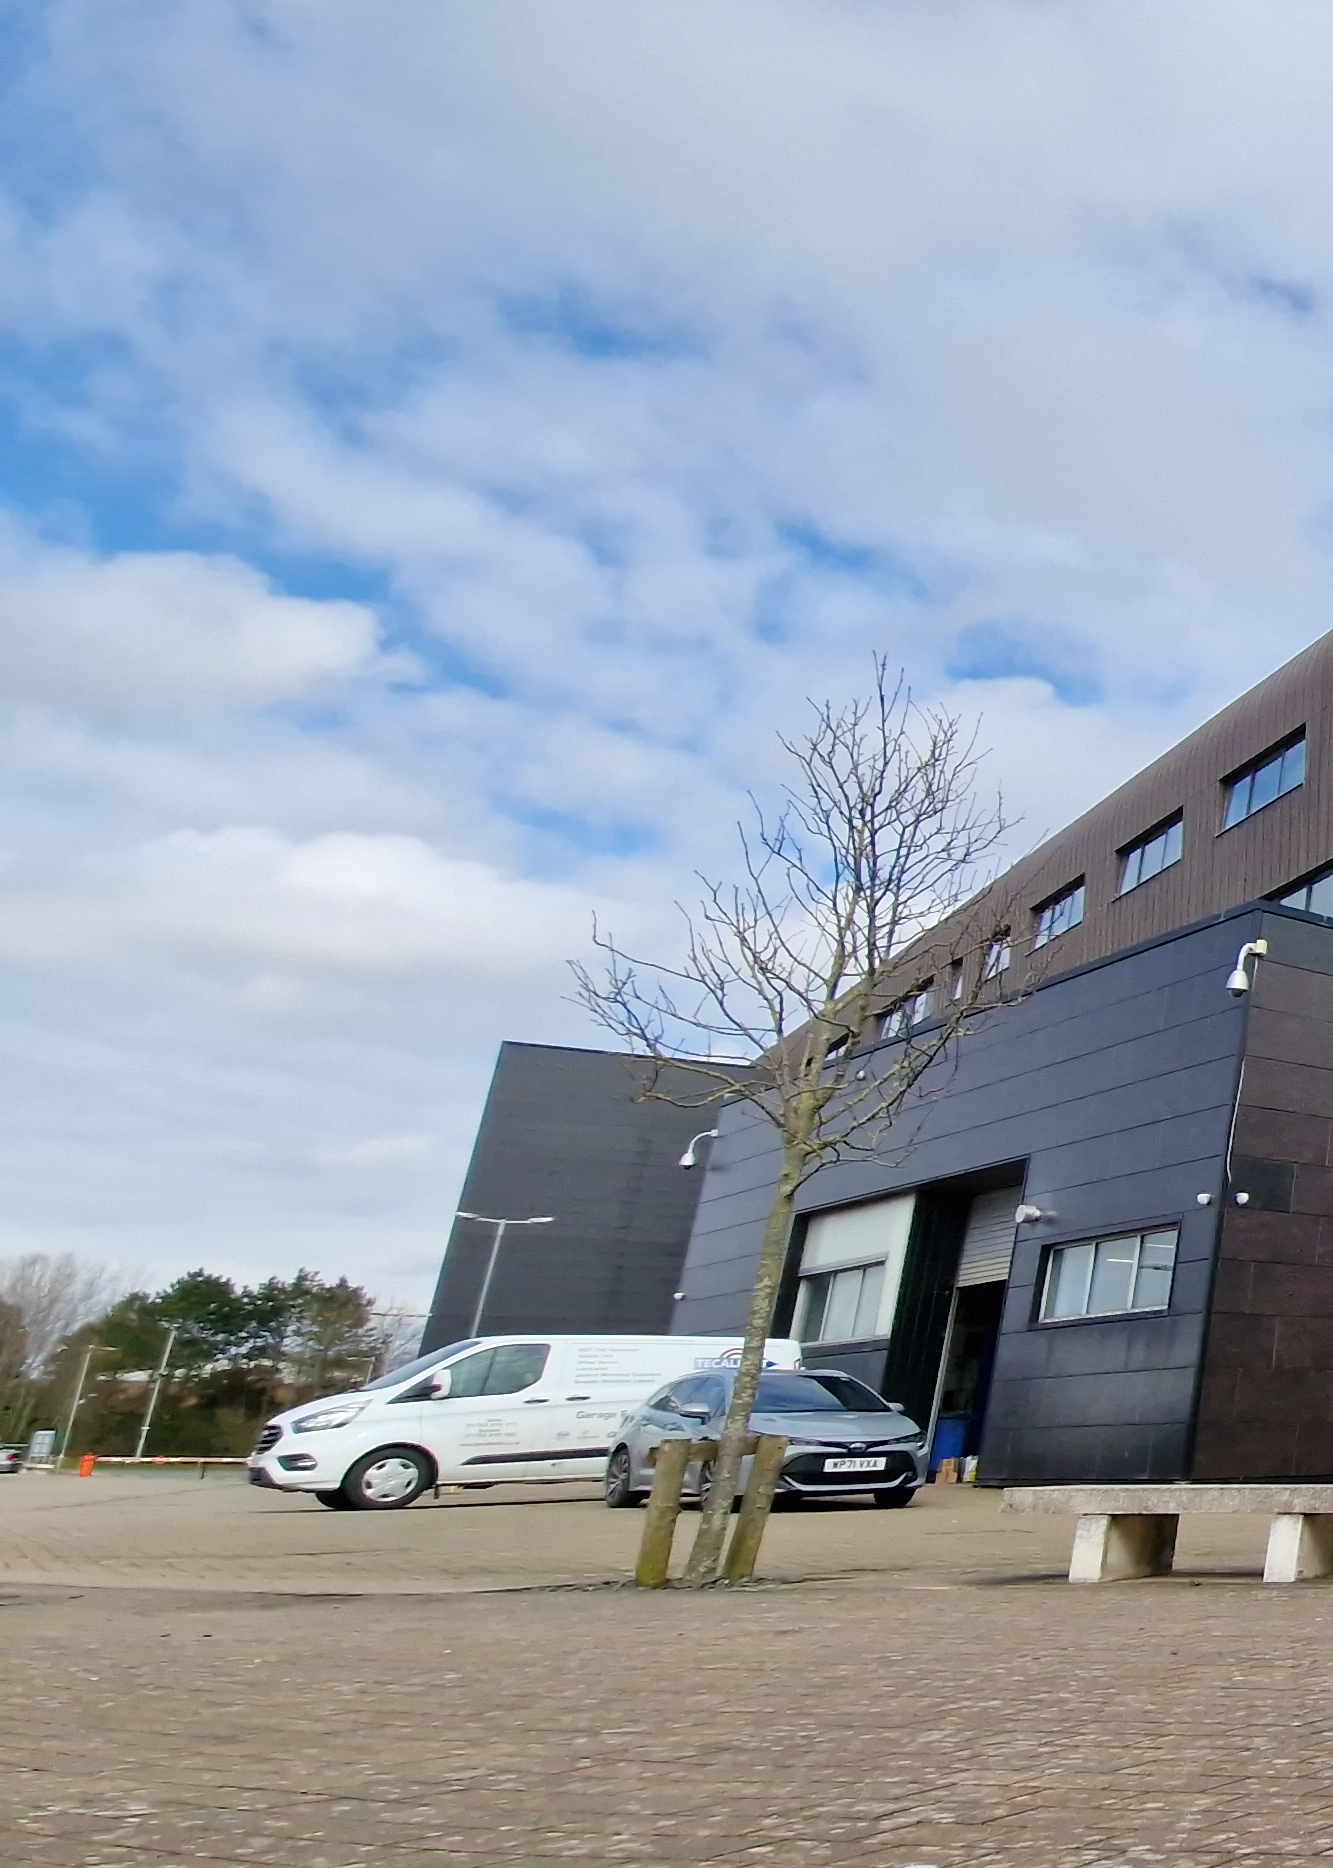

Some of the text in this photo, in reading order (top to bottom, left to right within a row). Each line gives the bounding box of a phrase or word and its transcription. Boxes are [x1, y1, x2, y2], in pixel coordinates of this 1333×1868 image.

[696, 1359, 764, 1369] TECAL
[576, 1411, 616, 1420] Garage
[860, 1460, 877, 1468] VXA
